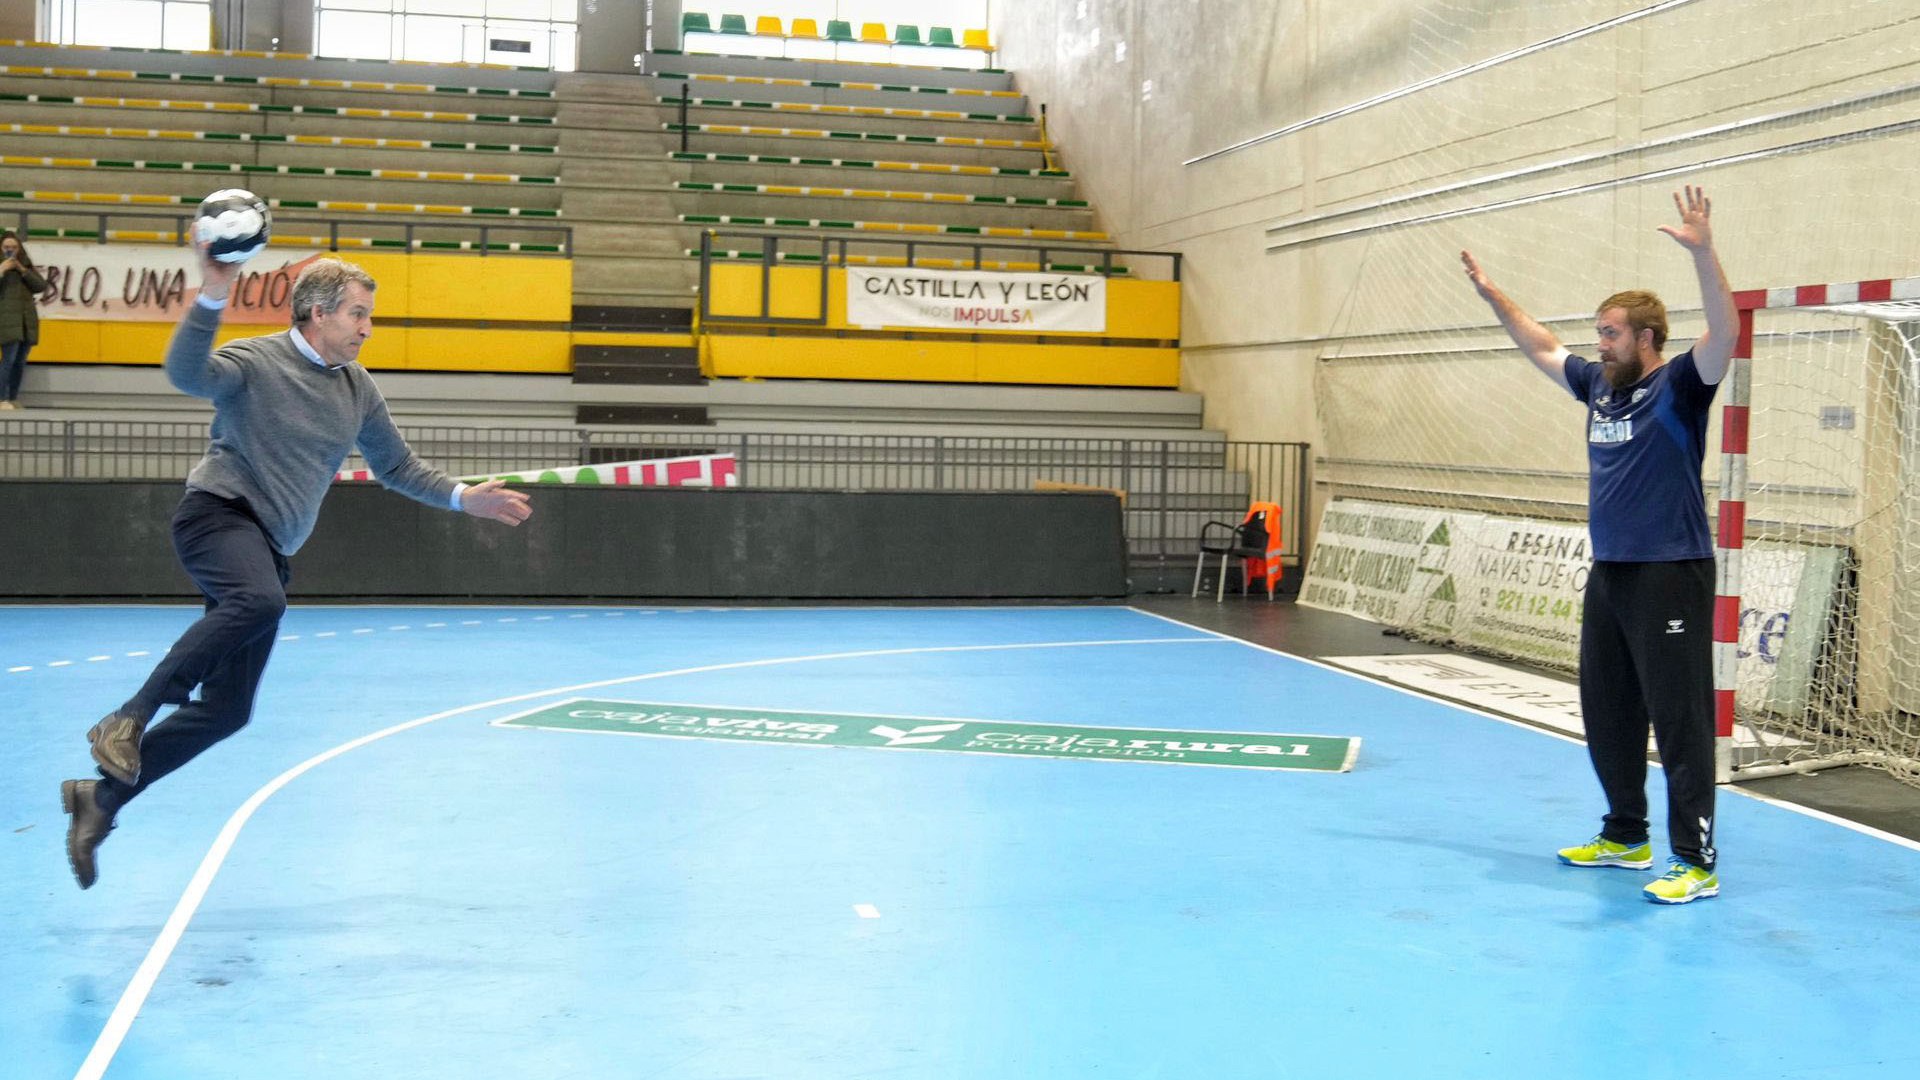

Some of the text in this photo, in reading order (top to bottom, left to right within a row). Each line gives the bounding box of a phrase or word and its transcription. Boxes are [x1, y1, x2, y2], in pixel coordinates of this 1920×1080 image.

[123, 267, 187, 308] UNA
[865, 276, 1090, 304] CASTILLA Y LEÓN
[919, 305, 1034, 325] NOS IMPULSA
[1506, 531, 1594, 563] RESINA
[1473, 553, 1534, 585] NAVAS
[1538, 561, 1567, 590] DE
[1496, 588, 1523, 612] 921
[1528, 594, 1548, 617] 12
[1551, 599, 1573, 621] 44
[962, 739, 1186, 758] Fundación
[976, 730, 1312, 757] cajarural
